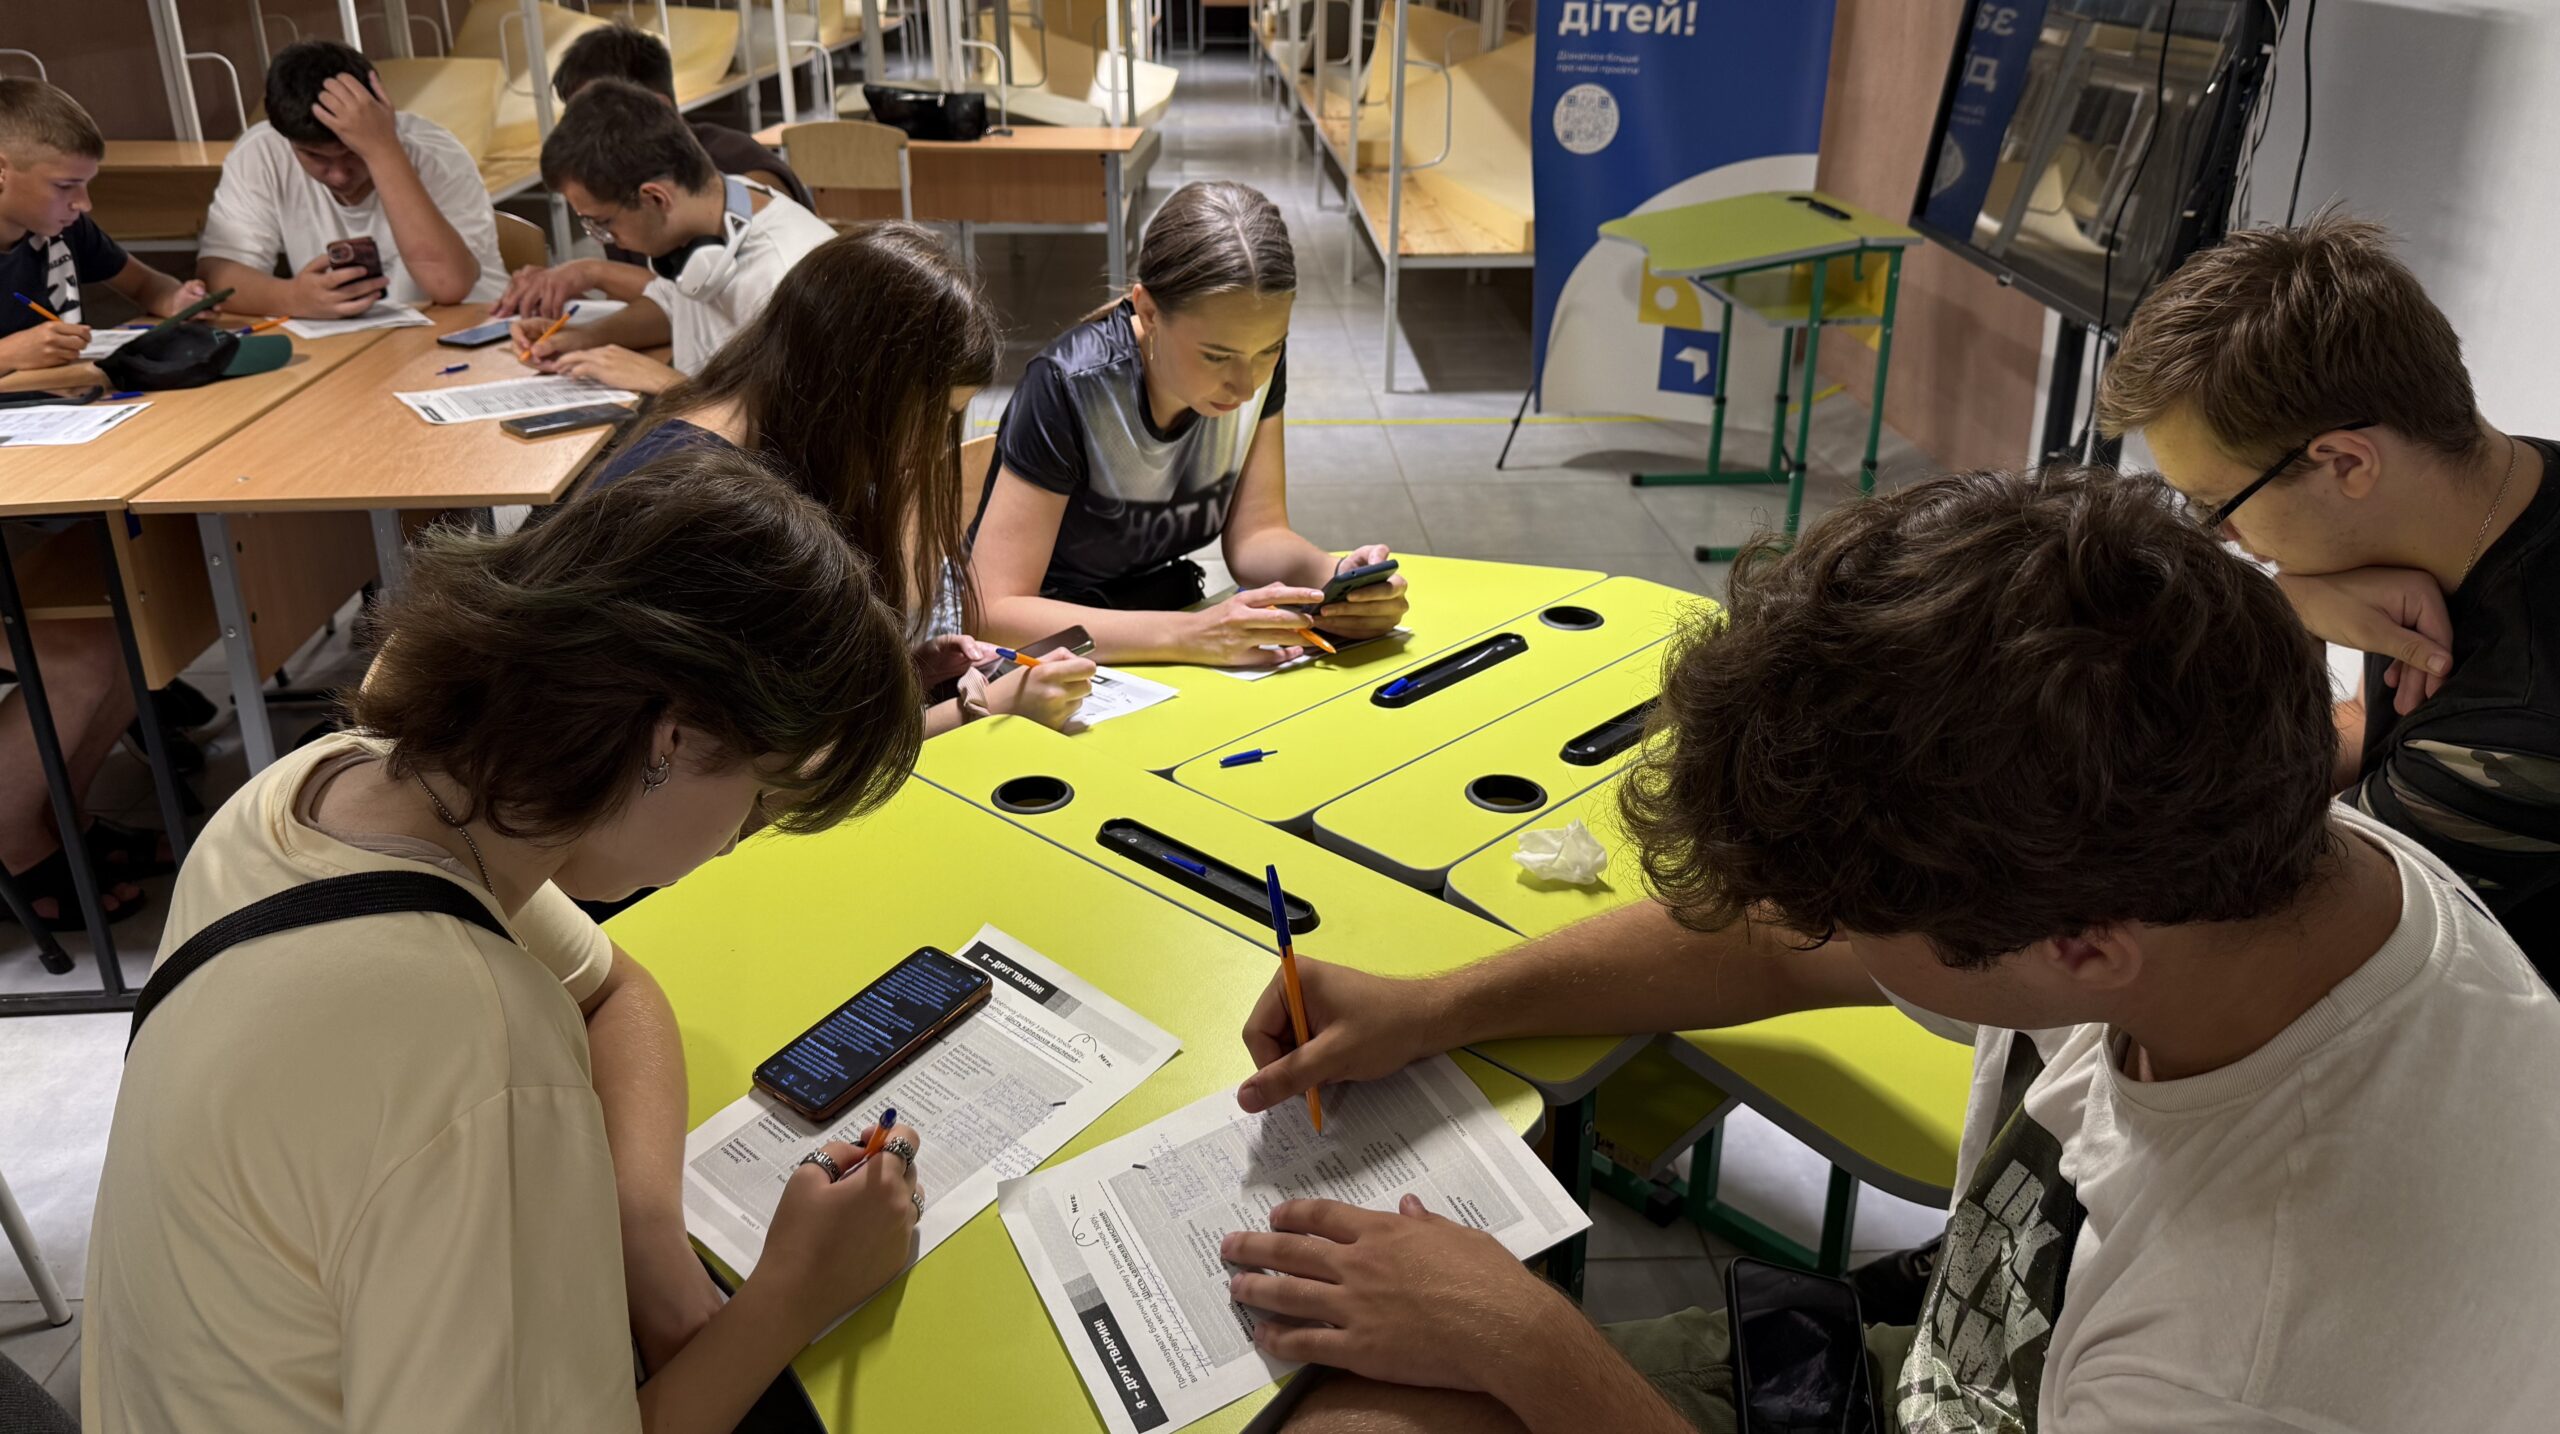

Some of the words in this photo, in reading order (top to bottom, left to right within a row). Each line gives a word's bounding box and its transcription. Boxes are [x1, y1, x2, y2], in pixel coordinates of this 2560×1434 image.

[1558, 0, 1698, 37] дітей!
[980, 952, 989, 960] Я
[991, 960, 1013, 973] ДРУГ
[1011, 971, 1043, 993] ТВАРИН!
[1021, 1025, 1050, 1045] капелюхів
[1098, 1053, 1111, 1067] Мета:
[1070, 1195, 1078, 1213] Мета:
[1090, 1214, 1100, 1230] зору,
[1099, 1211, 1121, 1243] мислення»
[1098, 1231, 1109, 1249] точок
[1108, 1249, 1122, 1269] різних
[1117, 1242, 1140, 1277] капелюхів
[1122, 1274, 1139, 1298] дилему
[1135, 1299, 1156, 1333] біоетичну
[1149, 1302, 1164, 1324] метод
[1094, 1319, 1121, 1363] ТВАРИН!
[1162, 1325, 1197, 1382] використовуючи
[1154, 1334, 1186, 1388] Проаналізувати
[1116, 1364, 1139, 1390] ДРУГ
[1135, 1399, 1147, 1409] Я
